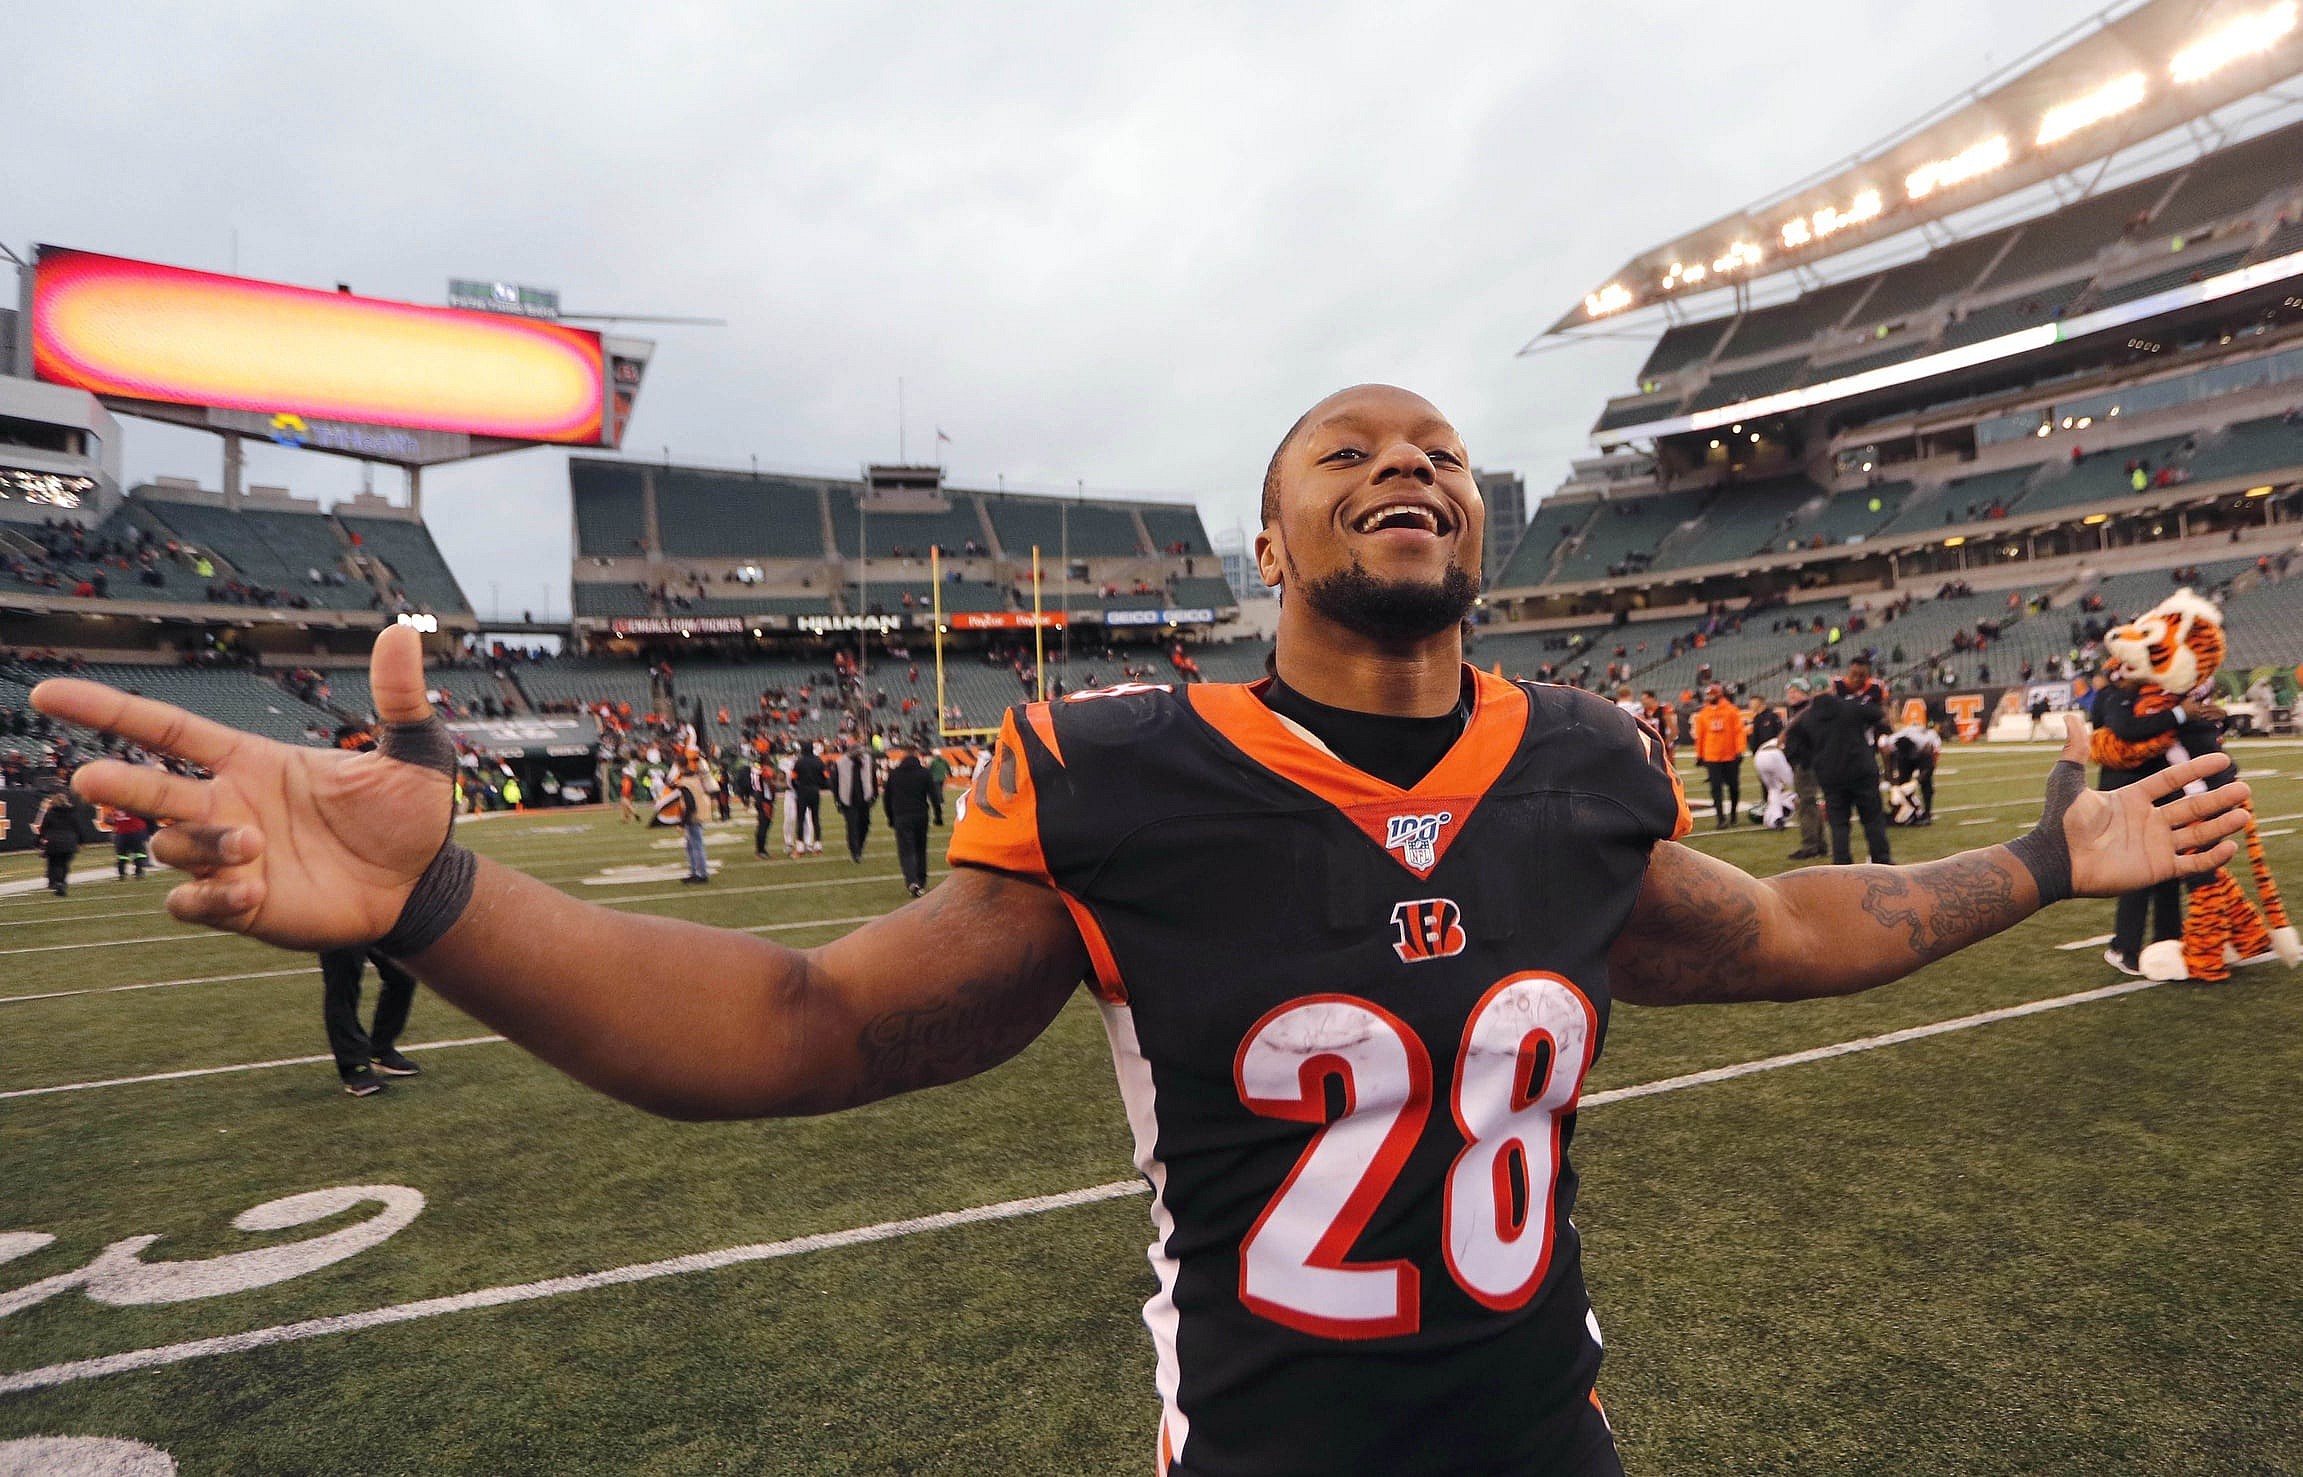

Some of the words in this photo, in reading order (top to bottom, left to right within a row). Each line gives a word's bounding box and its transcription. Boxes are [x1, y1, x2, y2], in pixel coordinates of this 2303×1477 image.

[797, 615, 901, 631] HILLMAN
[1107, 611, 1158, 625] GEICO
[1410, 848, 1432, 864] NFL
[1232, 968, 1599, 1340] 28
